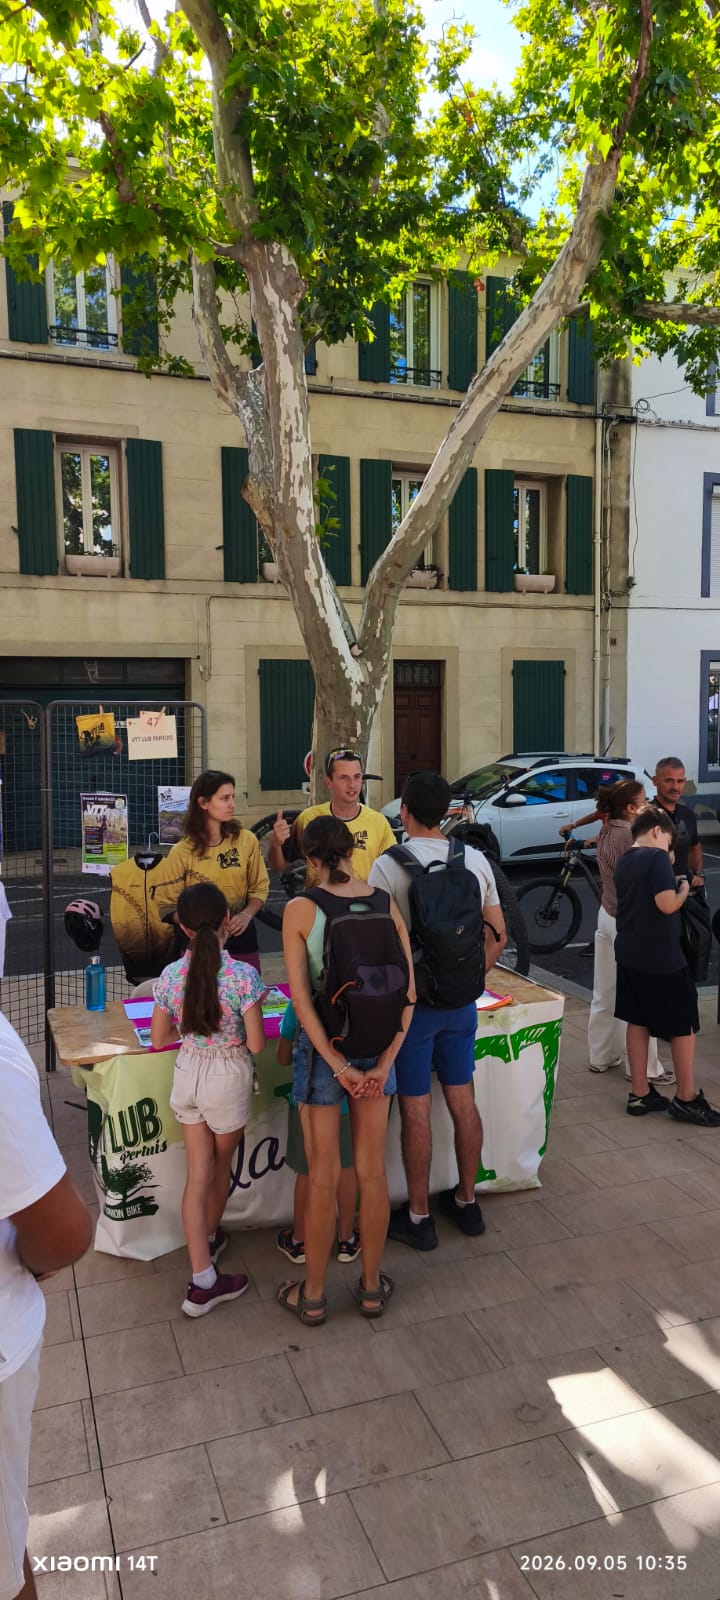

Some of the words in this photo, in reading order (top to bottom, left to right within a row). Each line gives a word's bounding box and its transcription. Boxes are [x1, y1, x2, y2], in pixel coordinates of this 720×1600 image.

[146, 717, 160, 728] 47
[120, 1139, 168, 1165] Pertuis
[126, 1203, 143, 1217] BIKE
